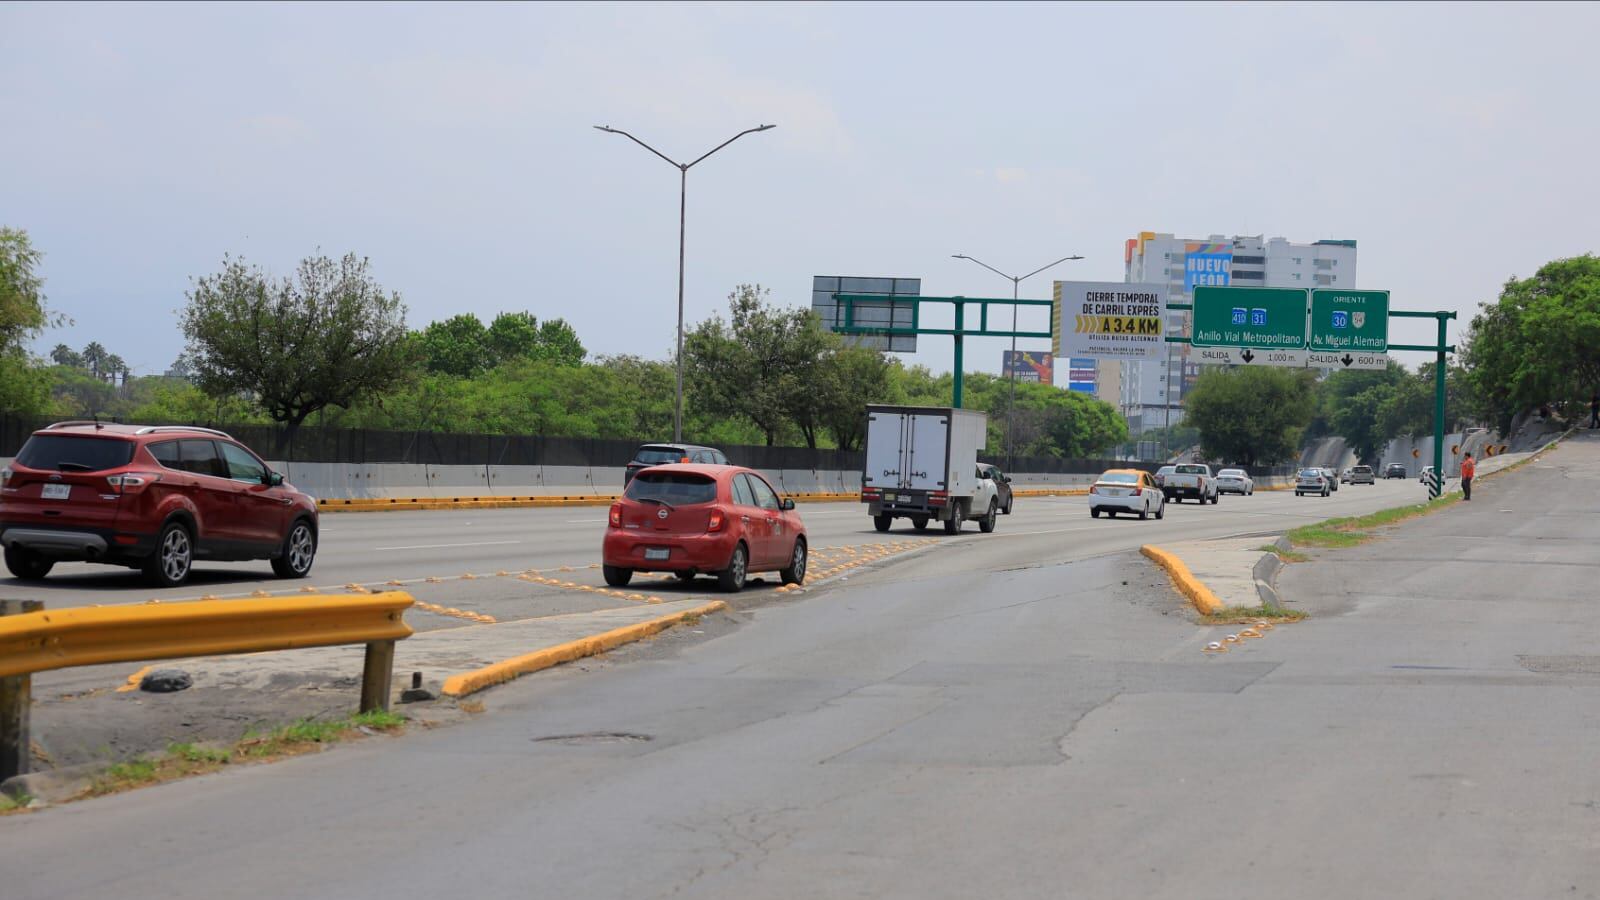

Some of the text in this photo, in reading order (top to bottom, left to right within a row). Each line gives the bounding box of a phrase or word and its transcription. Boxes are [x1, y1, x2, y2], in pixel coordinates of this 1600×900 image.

[1188, 258, 1230, 272] NUEVO
[1086, 291, 1159, 304] CIERRE TEMPORAL
[1333, 296, 1366, 304] ORIENTE
[1082, 303, 1159, 317] DE CARRIL EXPRÉS
[1232, 313, 1264, 324] 410 31
[1333, 316, 1346, 326] 30
[1102, 318, 1159, 334] A 3.4 KM
[1198, 330, 1301, 345] Anillo Vial Metropolitano
[1325, 335, 1351, 348] Miguel
[1202, 350, 1230, 360] SALIDA
[1308, 355, 1339, 364] SALIDA
[1358, 356, 1374, 365] 600
